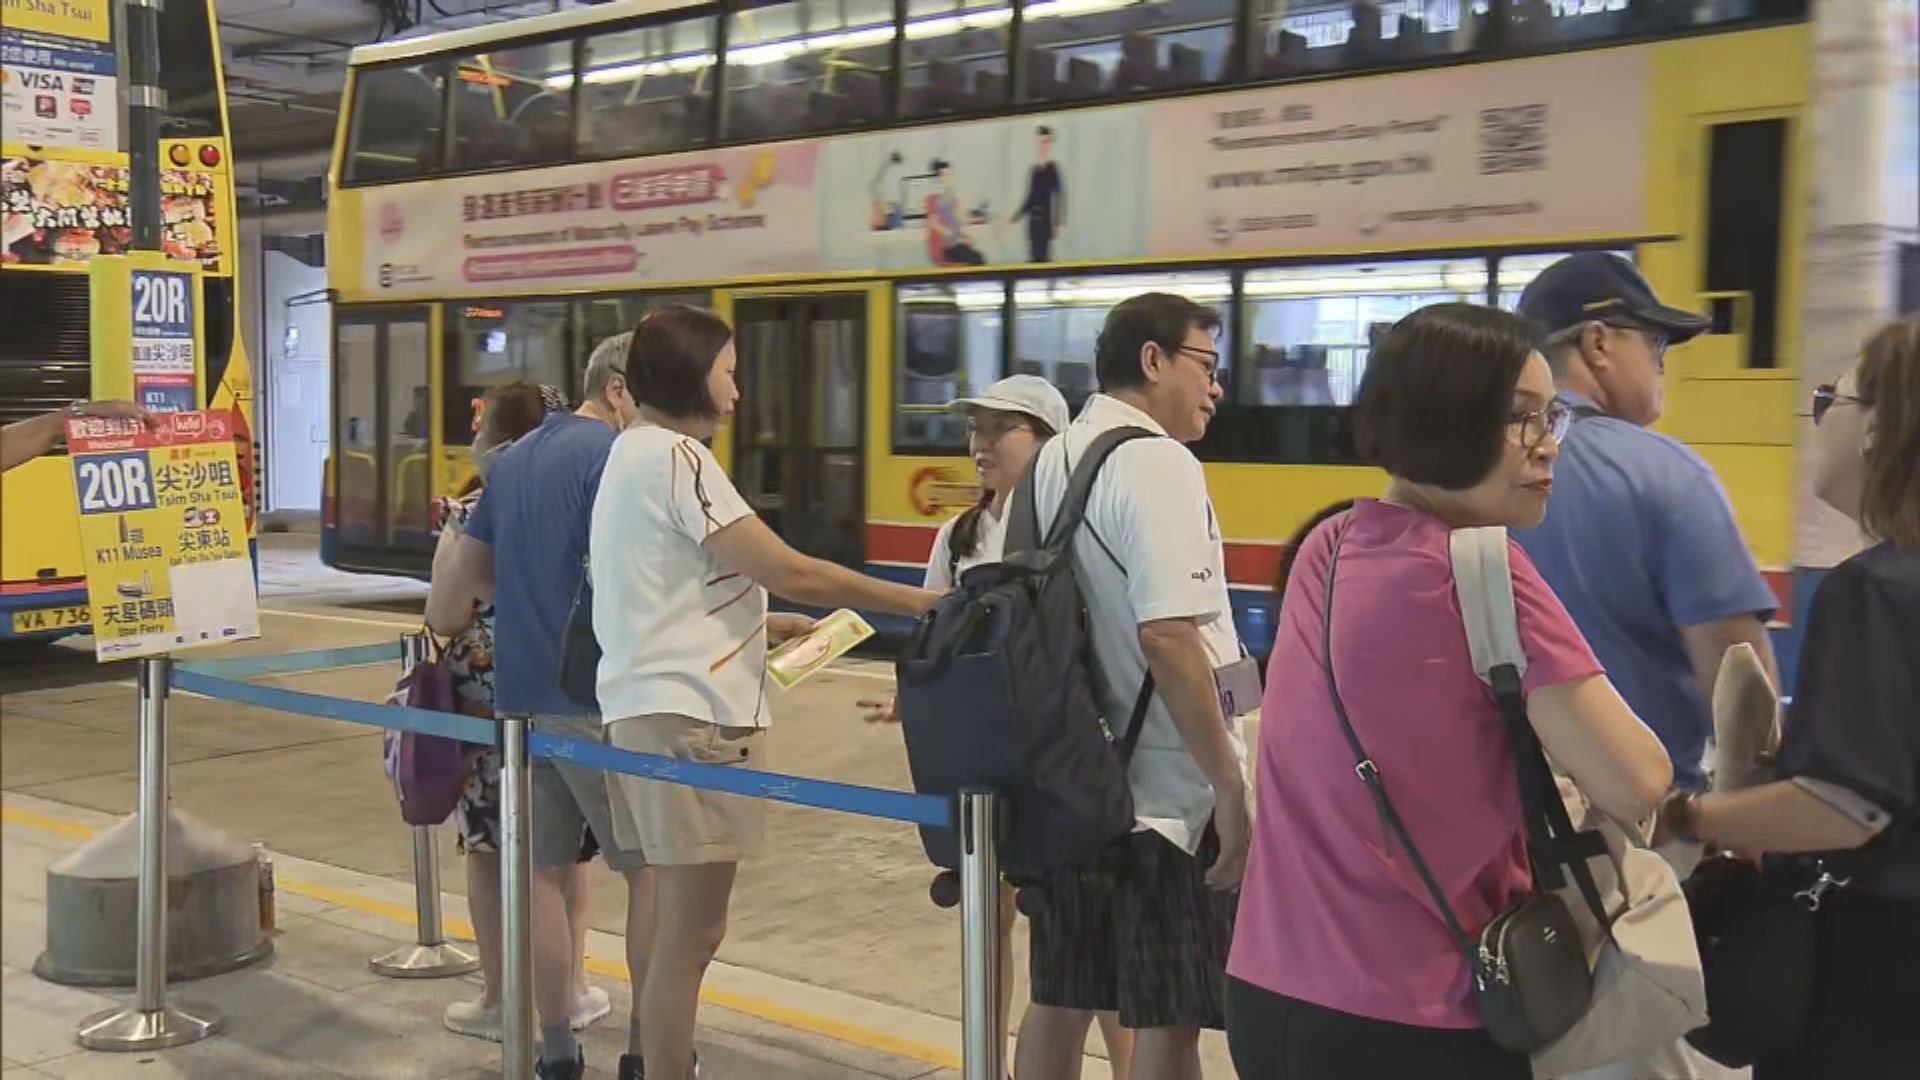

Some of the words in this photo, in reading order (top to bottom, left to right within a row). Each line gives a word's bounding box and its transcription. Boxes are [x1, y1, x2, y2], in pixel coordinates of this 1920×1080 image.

[61, 2, 92, 20] Tsui
[19, 71, 64, 91] VISA
[135, 276, 185, 323] 20R
[80, 458, 151, 510] 20R
[156, 460, 234, 492] 尖沙咀
[158, 495, 187, 507] Tsim
[190, 492, 211, 503] Sha
[178, 528, 231, 552] 尖東站
[96, 548, 119, 563] K11
[123, 545, 163, 561] Musea
[21, 612, 46, 629] VA
[53, 607, 90, 627] 736
[101, 597, 175, 625] 天星碼頭
[140, 624, 165, 635] Ferry
